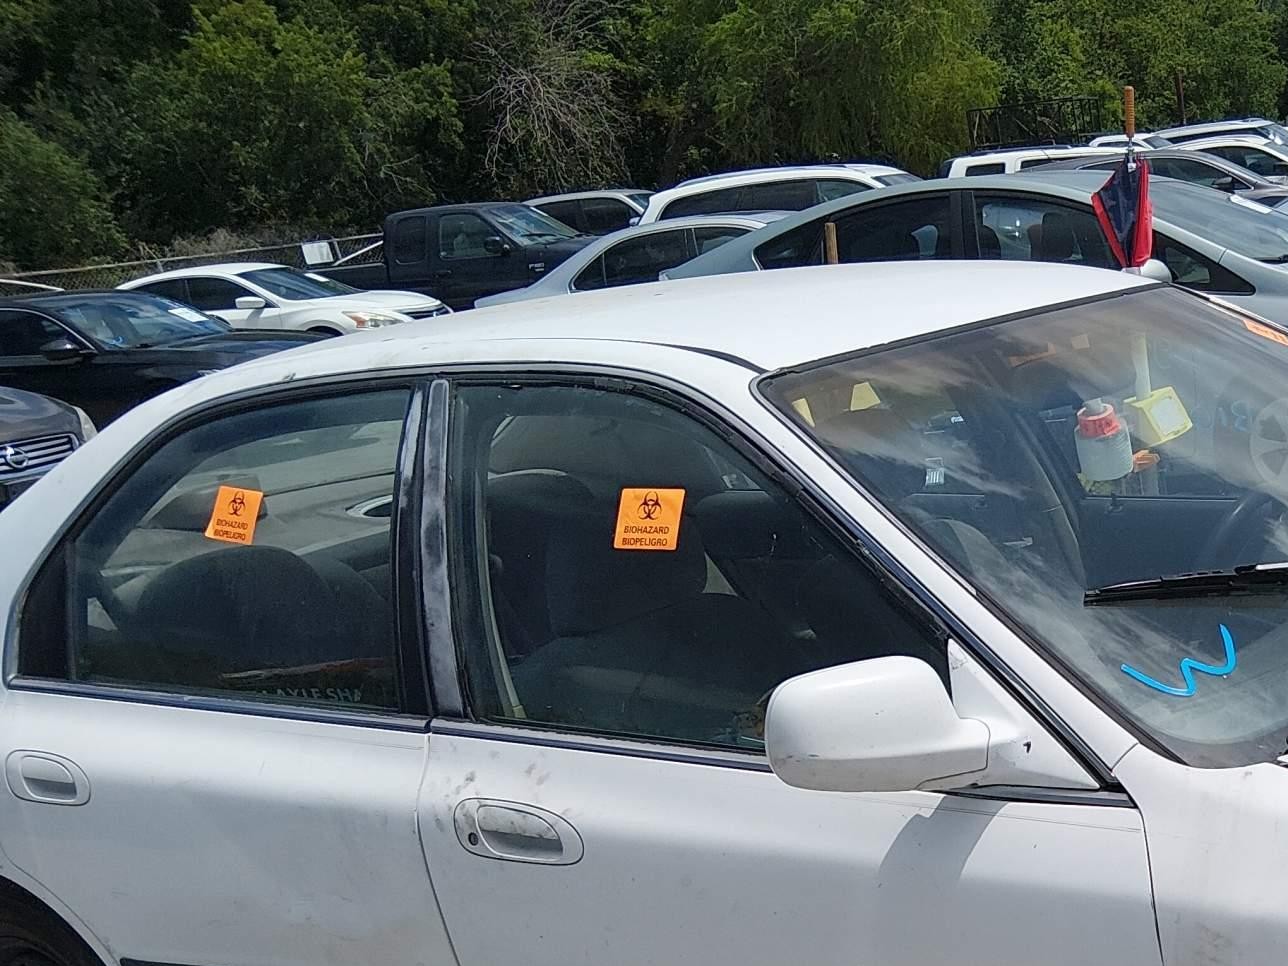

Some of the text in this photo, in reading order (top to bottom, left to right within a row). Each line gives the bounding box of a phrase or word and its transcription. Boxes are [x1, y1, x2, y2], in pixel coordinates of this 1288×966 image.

[216, 518, 249, 530] BIOHAZARD
[623, 525, 670, 534] BIOHAZARD
[622, 537, 668, 546] BIOPELIGRO
